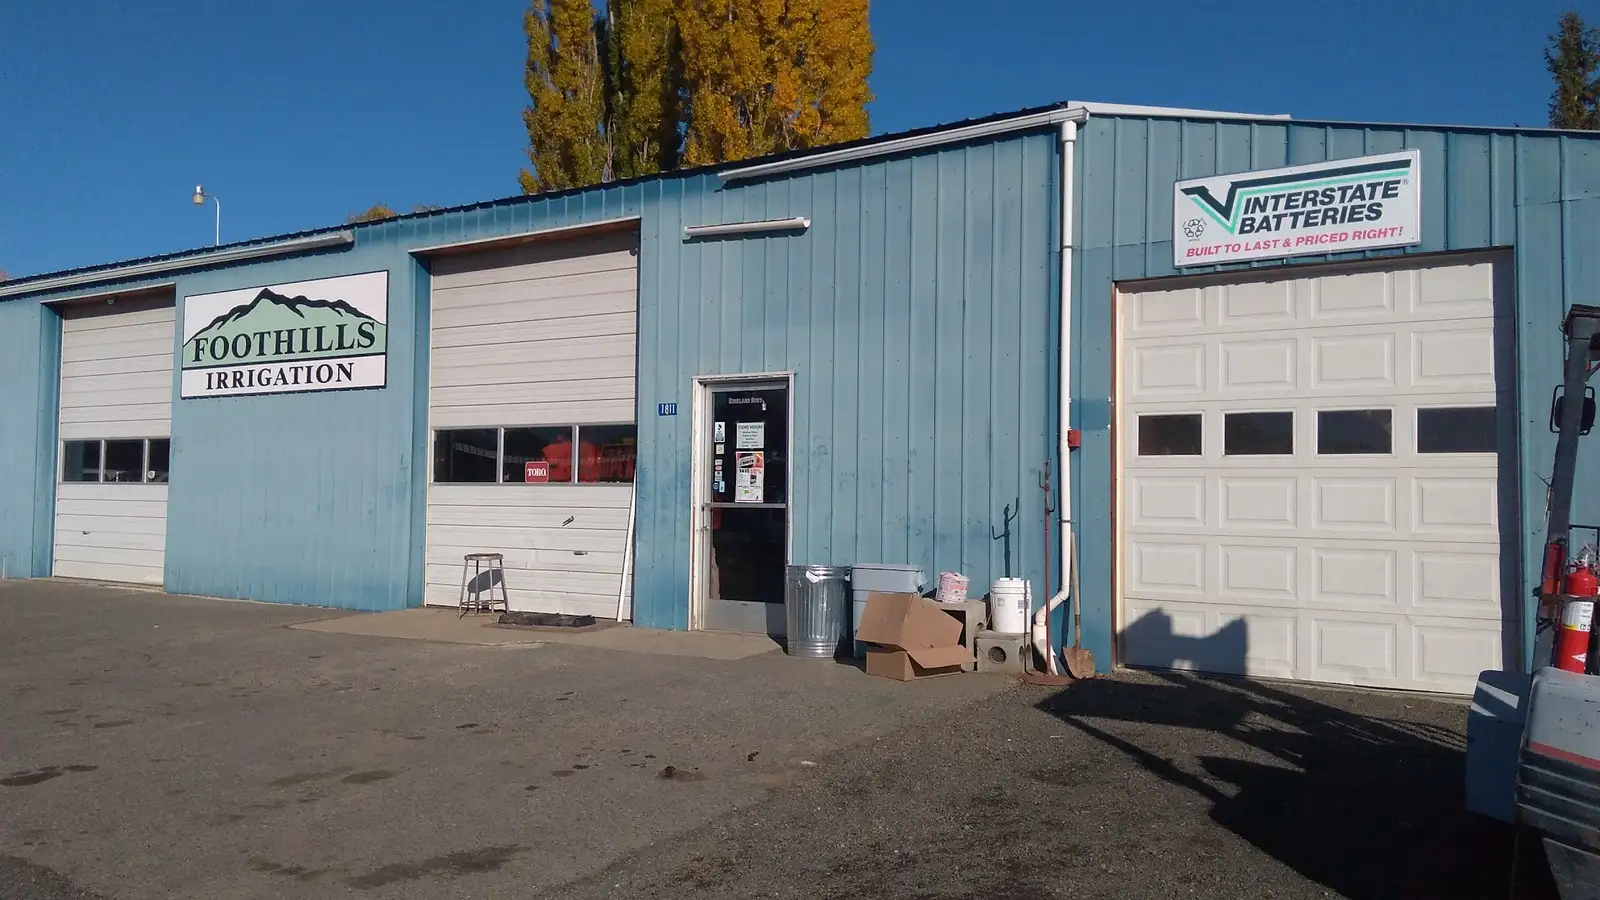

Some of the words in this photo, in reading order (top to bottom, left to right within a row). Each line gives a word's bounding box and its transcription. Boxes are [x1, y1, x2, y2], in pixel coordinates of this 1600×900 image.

[1238, 202, 1383, 235] BATTERIES
[1186, 245, 1221, 257] BUILT
[1225, 243, 1241, 253] TO
[1244, 239, 1280, 251] LAST
[1282, 238, 1291, 247] &
[1295, 232, 1348, 246] PRICED
[1352, 226, 1404, 240] RIGHT!
[192, 321, 376, 363] FOOTHILLS
[206, 362, 354, 391] IRRIGATION
[527, 468, 547, 476] TORO
